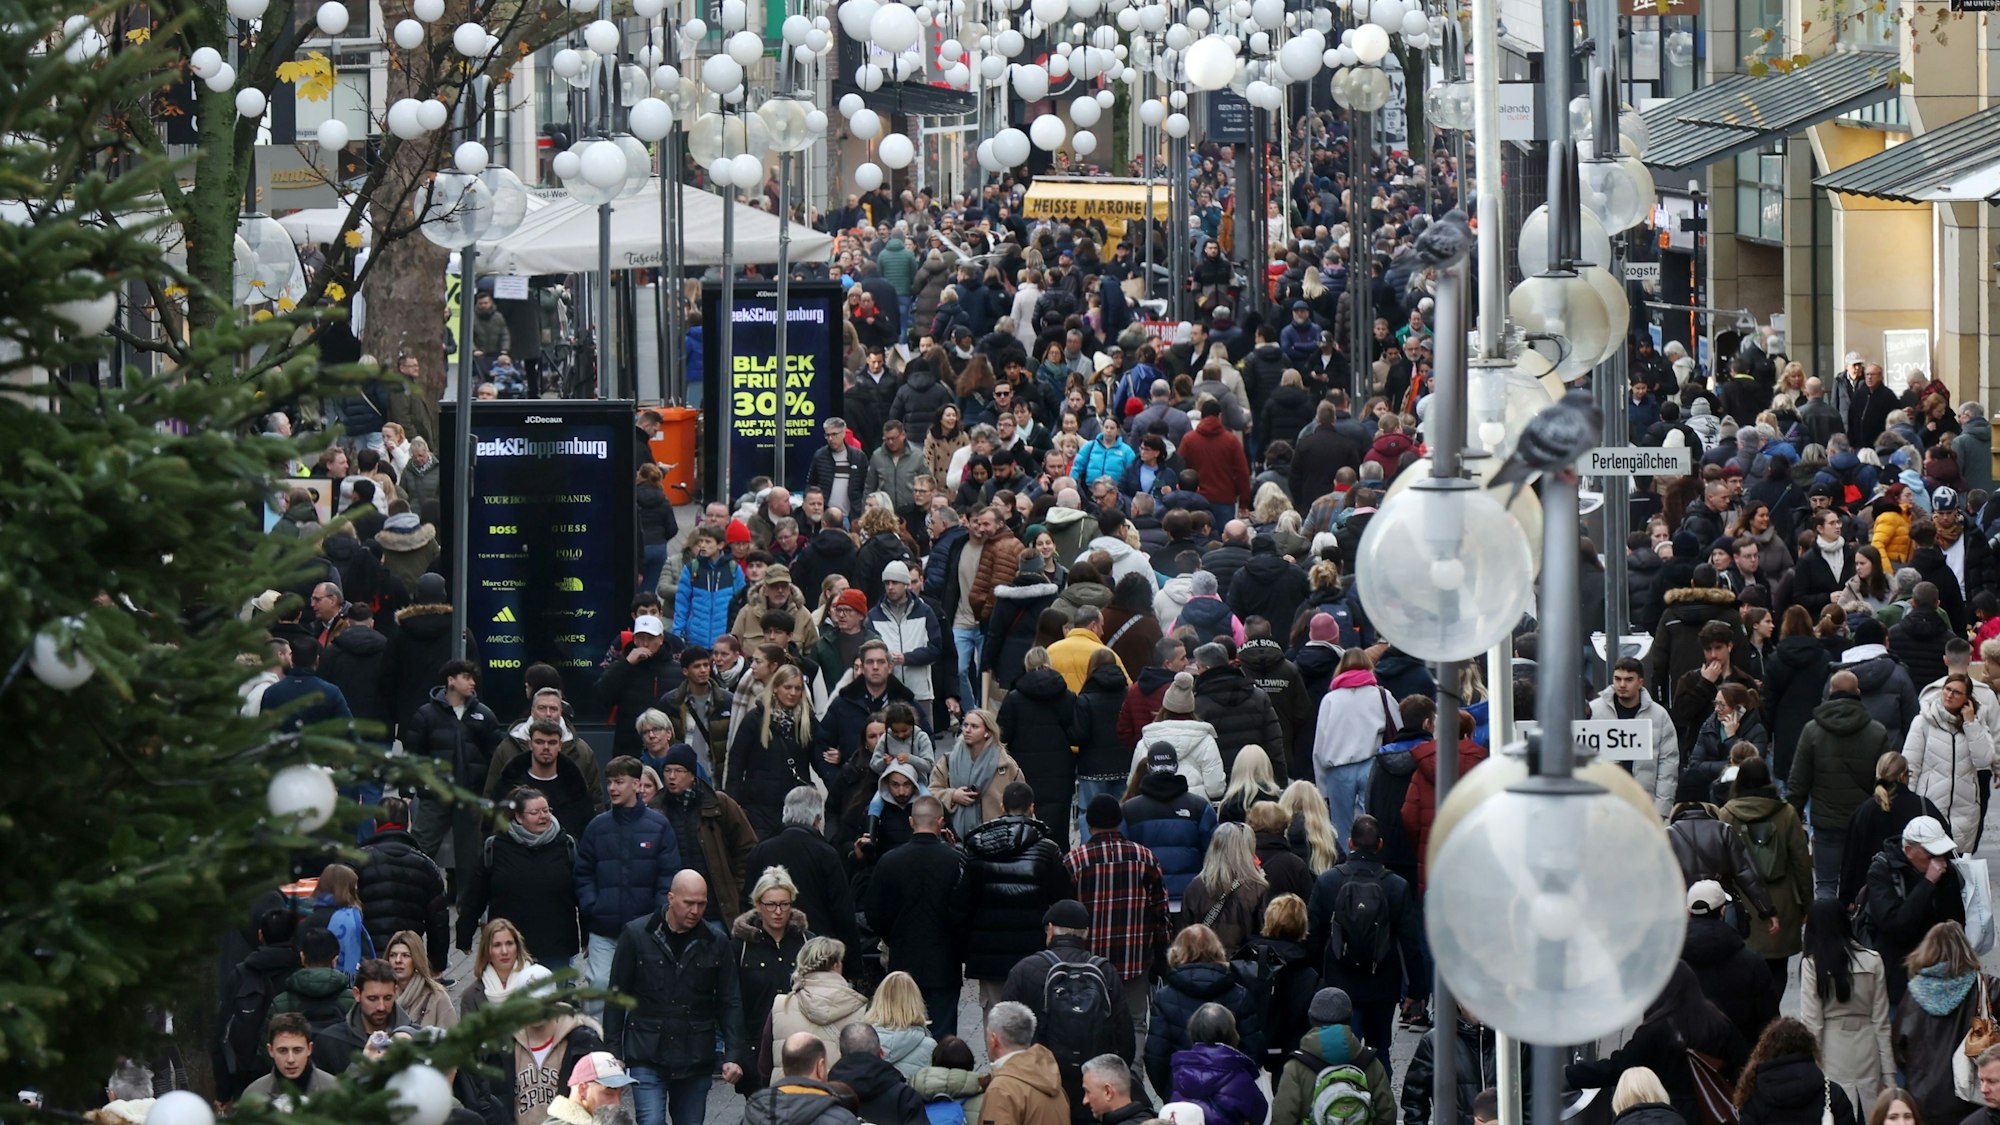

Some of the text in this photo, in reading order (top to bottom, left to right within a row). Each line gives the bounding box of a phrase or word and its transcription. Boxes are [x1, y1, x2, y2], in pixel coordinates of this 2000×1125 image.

[1499, 104, 1530, 113] alando
[1033, 199, 1147, 215] HEISSE MARONE
[1625, 266, 1660, 278] zogstr.
[732, 306, 824, 325] eek&Clopenburg
[732, 354, 816, 372] BLACK
[733, 391, 816, 416] 30%
[524, 416, 563, 424] JCDecaux
[733, 419, 816, 428] AUF TAUENDE
[738, 429, 763, 437] TOP
[475, 436, 608, 459] eek&Cloppenburg
[1592, 452, 1678, 473] Perlengäßchen
[483, 496, 509, 504] YOUR
[489, 525, 518, 534] BOSS
[482, 579, 501, 587] Marc
[489, 659, 521, 669] HUGO
[573, 658, 593, 667] Klein
[1607, 728, 1642, 749] Str.
